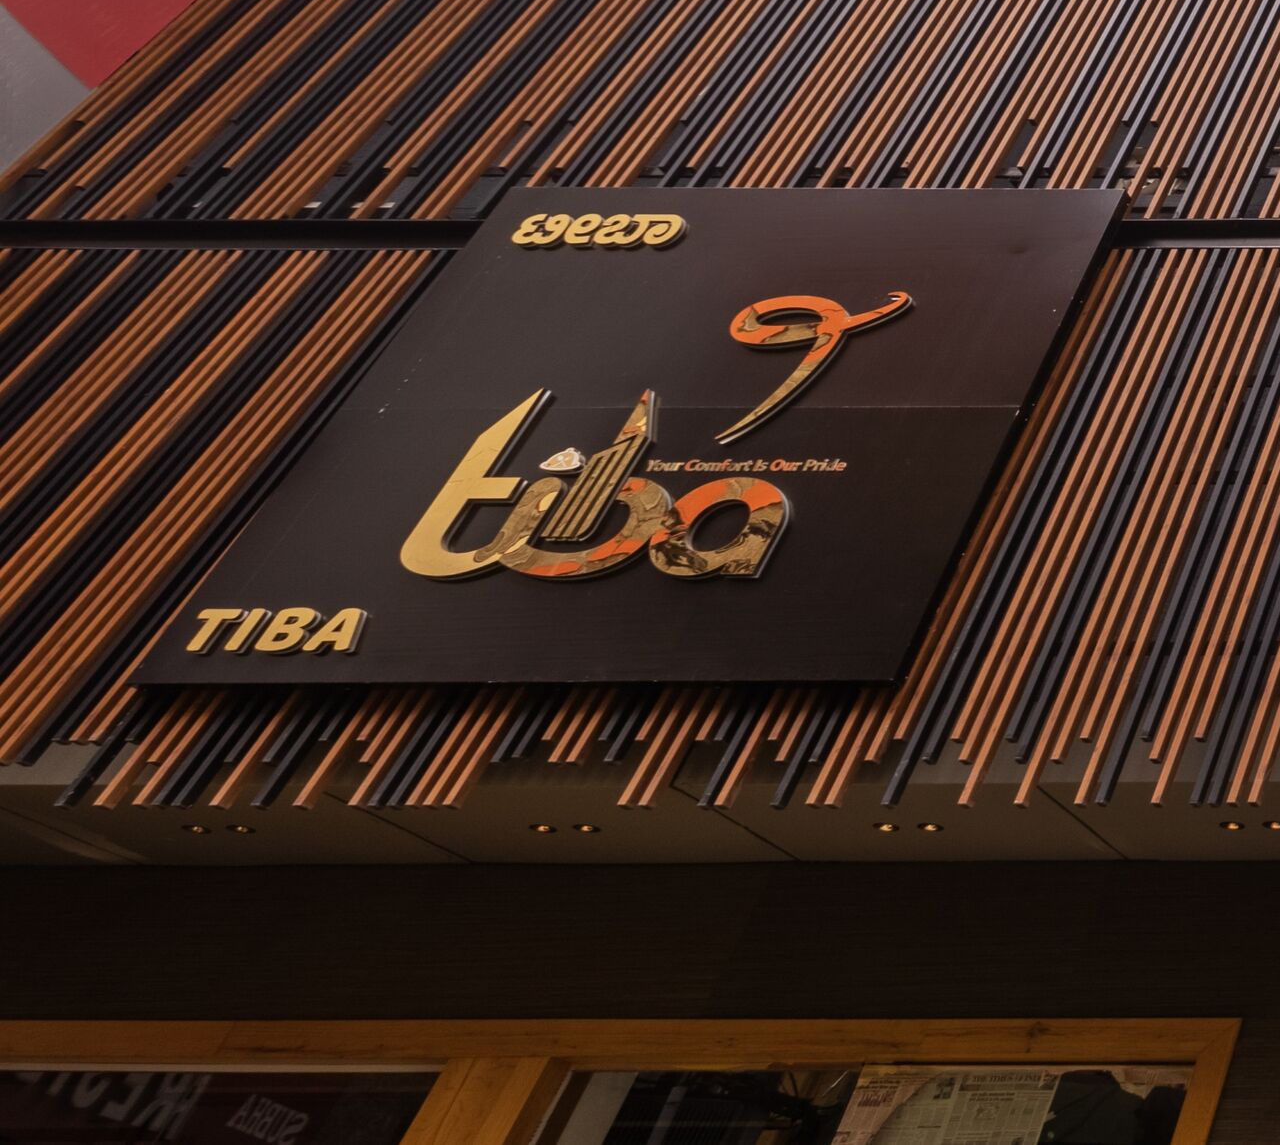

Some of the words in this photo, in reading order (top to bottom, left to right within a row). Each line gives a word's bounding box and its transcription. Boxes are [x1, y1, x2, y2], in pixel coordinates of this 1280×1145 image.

[511, 213, 686, 248] ಟೀಬಾ
[399, 387, 792, 580] tiba
[645, 458, 684, 472] Your
[684, 458, 752, 472] Comfort
[753, 458, 768, 472] Is
[769, 458, 802, 472] Our
[802, 458, 848, 472] Pride
[184, 605, 368, 657] TIBA
